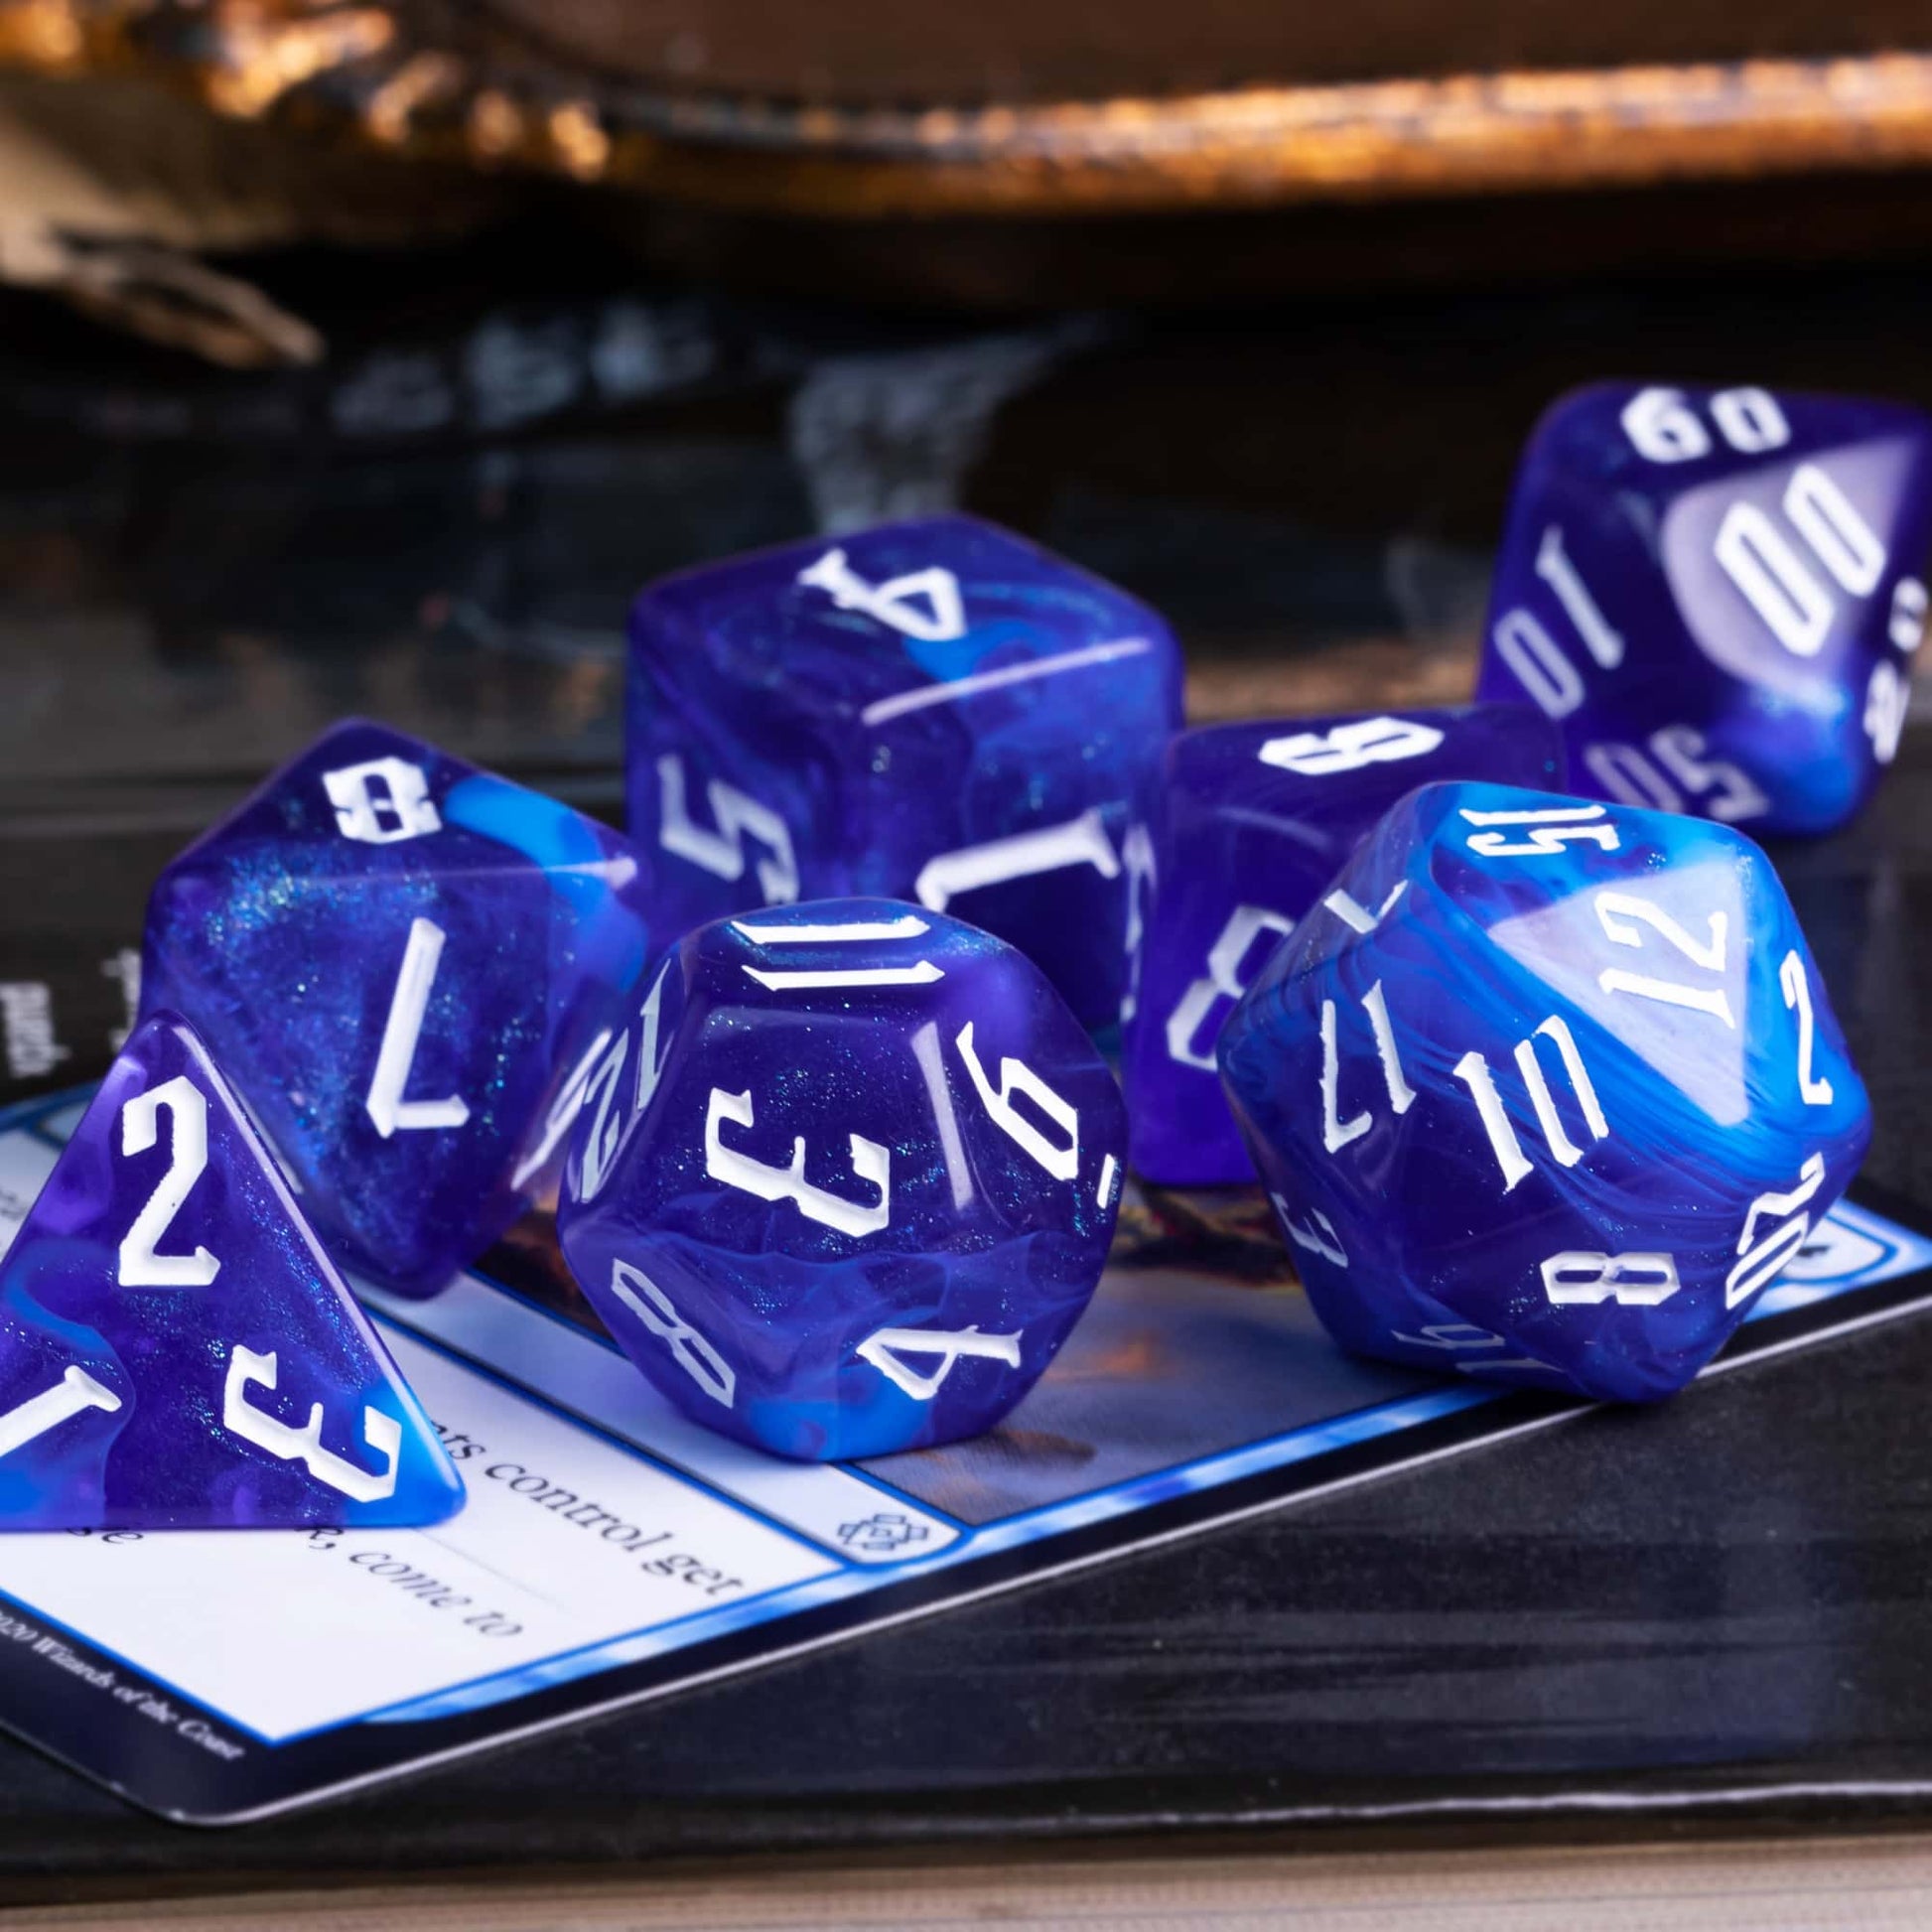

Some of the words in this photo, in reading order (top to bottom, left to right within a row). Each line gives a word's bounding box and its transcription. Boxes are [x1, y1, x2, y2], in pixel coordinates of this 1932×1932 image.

[799, 549, 965, 641] 4
[1715, 465, 1884, 656] 00
[323, 756, 442, 844] 8
[655, 754, 798, 905] 5
[366, 916, 470, 1139] 7
[731, 915, 945, 991] 11
[1595, 892, 1735, 1030] 12
[1779, 949, 1833, 1105] 2
[1319, 979, 1417, 1154] 17
[1453, 1015, 1608, 1194] 10
[118, 1075, 220, 1286] 2
[705, 1087, 890, 1238] 3
[1725, 1151, 1826, 1311] 20
[612, 1257, 736, 1409] 8
[1540, 1251, 1680, 1305] 8
[224, 1344, 402, 1503] 3
[856, 1324, 1023, 1401] 4
[349, 1552, 472, 1607] come
[463, 1610, 524, 1637] to
[484, 1461, 673, 1553] control
[640, 1553, 744, 1595] get
[31, 1636, 115, 1688] Wizards
[112, 1686, 154, 1704] of
[177, 1719, 245, 1760] Coast
